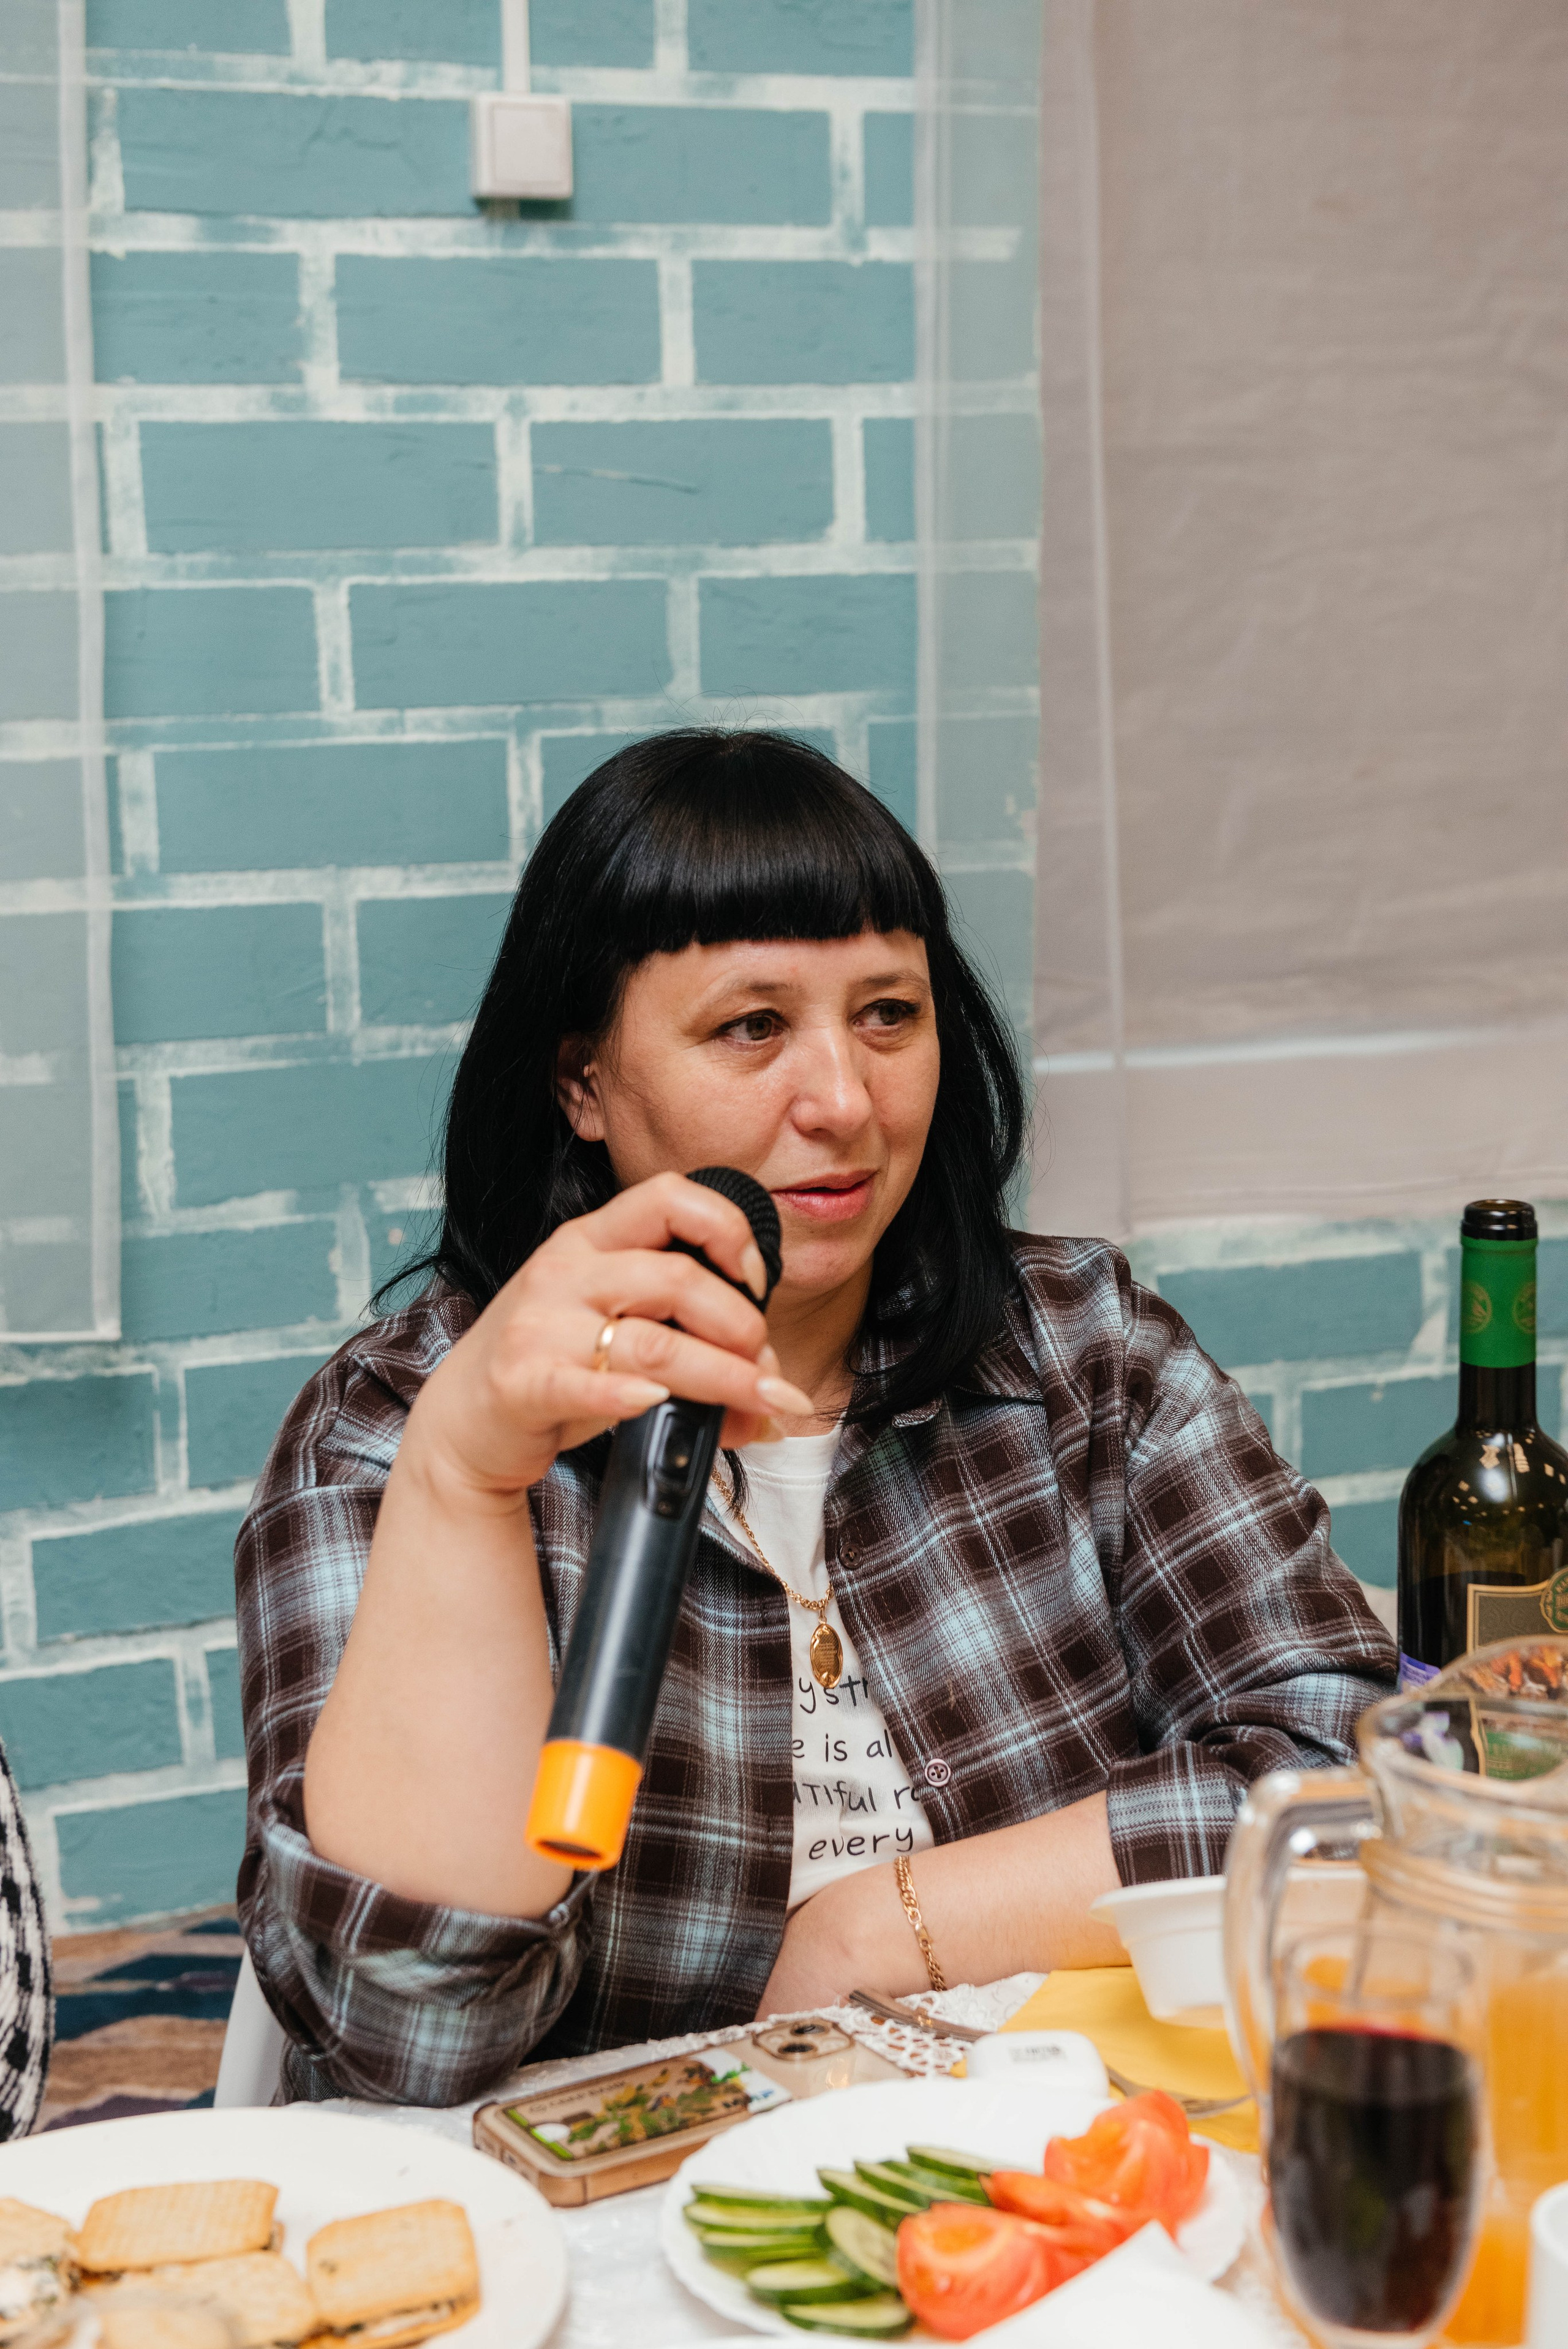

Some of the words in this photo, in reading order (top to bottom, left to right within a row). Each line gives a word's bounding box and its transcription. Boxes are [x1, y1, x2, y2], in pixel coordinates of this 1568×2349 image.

[824, 1733, 848, 1762] is
[866, 1729, 893, 1759] al
[809, 1827, 914, 1860] every
